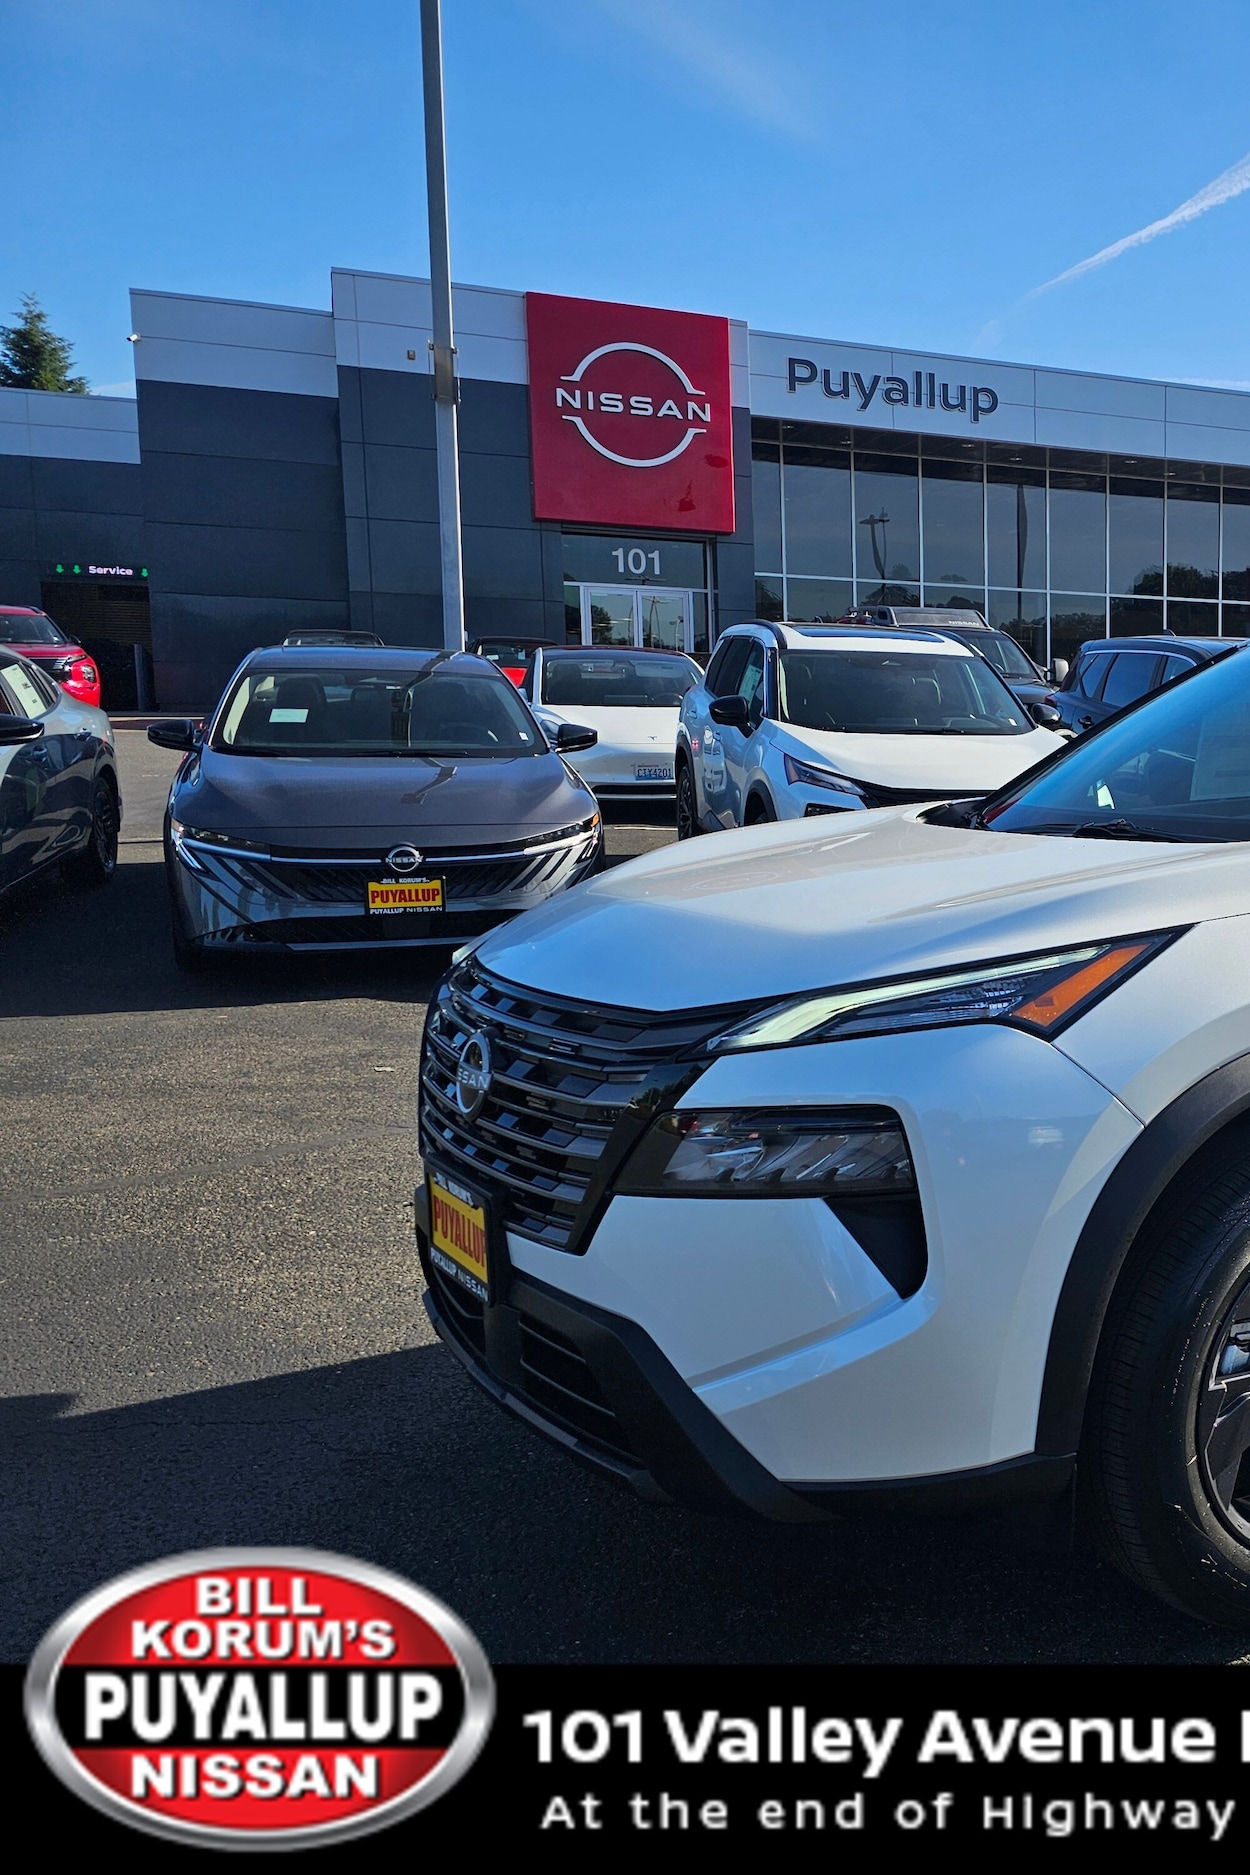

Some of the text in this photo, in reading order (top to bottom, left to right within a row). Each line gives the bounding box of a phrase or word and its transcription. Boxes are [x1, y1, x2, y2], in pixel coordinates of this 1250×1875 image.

[786, 357, 999, 423] Puyallup
[556, 387, 711, 422] NISSAN
[88, 565, 133, 576] Service
[611, 547, 660, 575] 101
[385, 855, 423, 863] NISSAN
[370, 888, 440, 904] PUYALLUP
[457, 1268, 489, 1302] NISSAN
